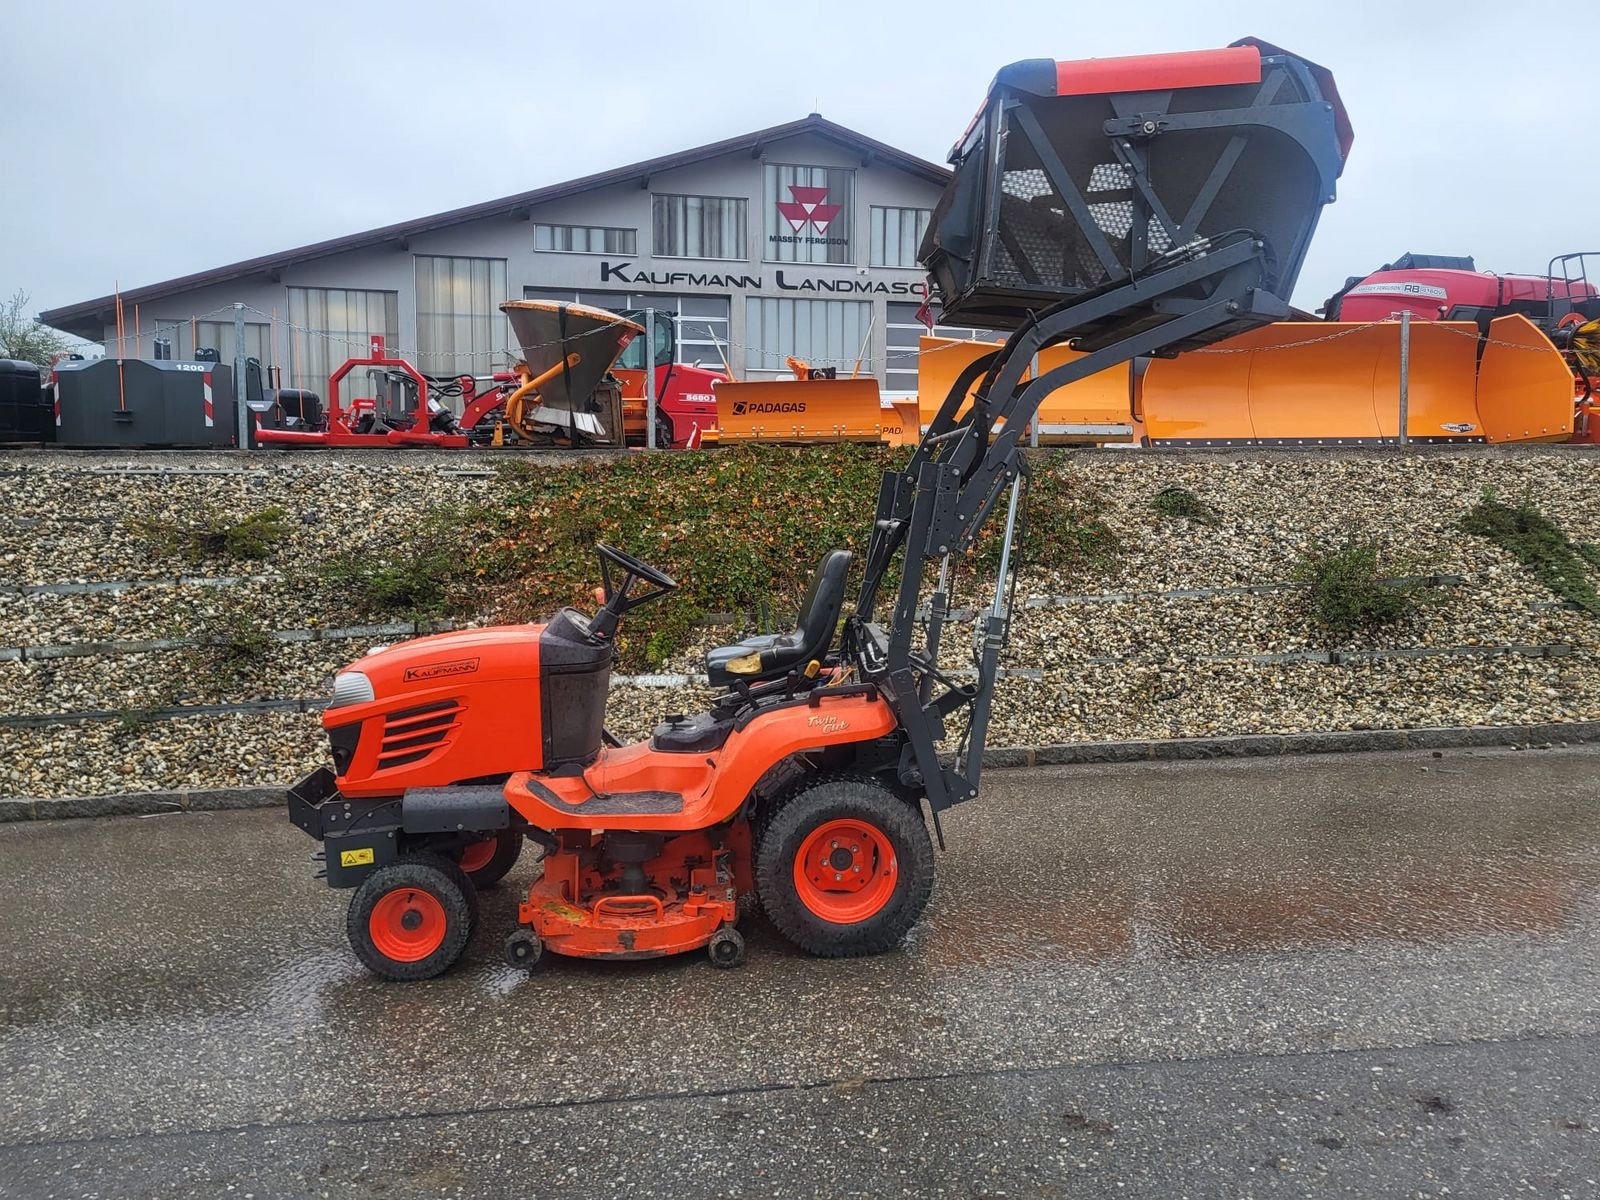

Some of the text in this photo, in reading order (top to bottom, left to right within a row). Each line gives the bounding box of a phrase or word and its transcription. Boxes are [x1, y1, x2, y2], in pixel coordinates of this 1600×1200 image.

[769, 235, 849, 246] MASSEY FERGUSON
[600, 261, 927, 296] KAUFMANN LANDMASC
[176, 364, 205, 372] 1200
[748, 402, 806, 413] PADAGAS
[407, 665, 475, 679] KAUFMANN
[808, 715, 837, 727] Twin
